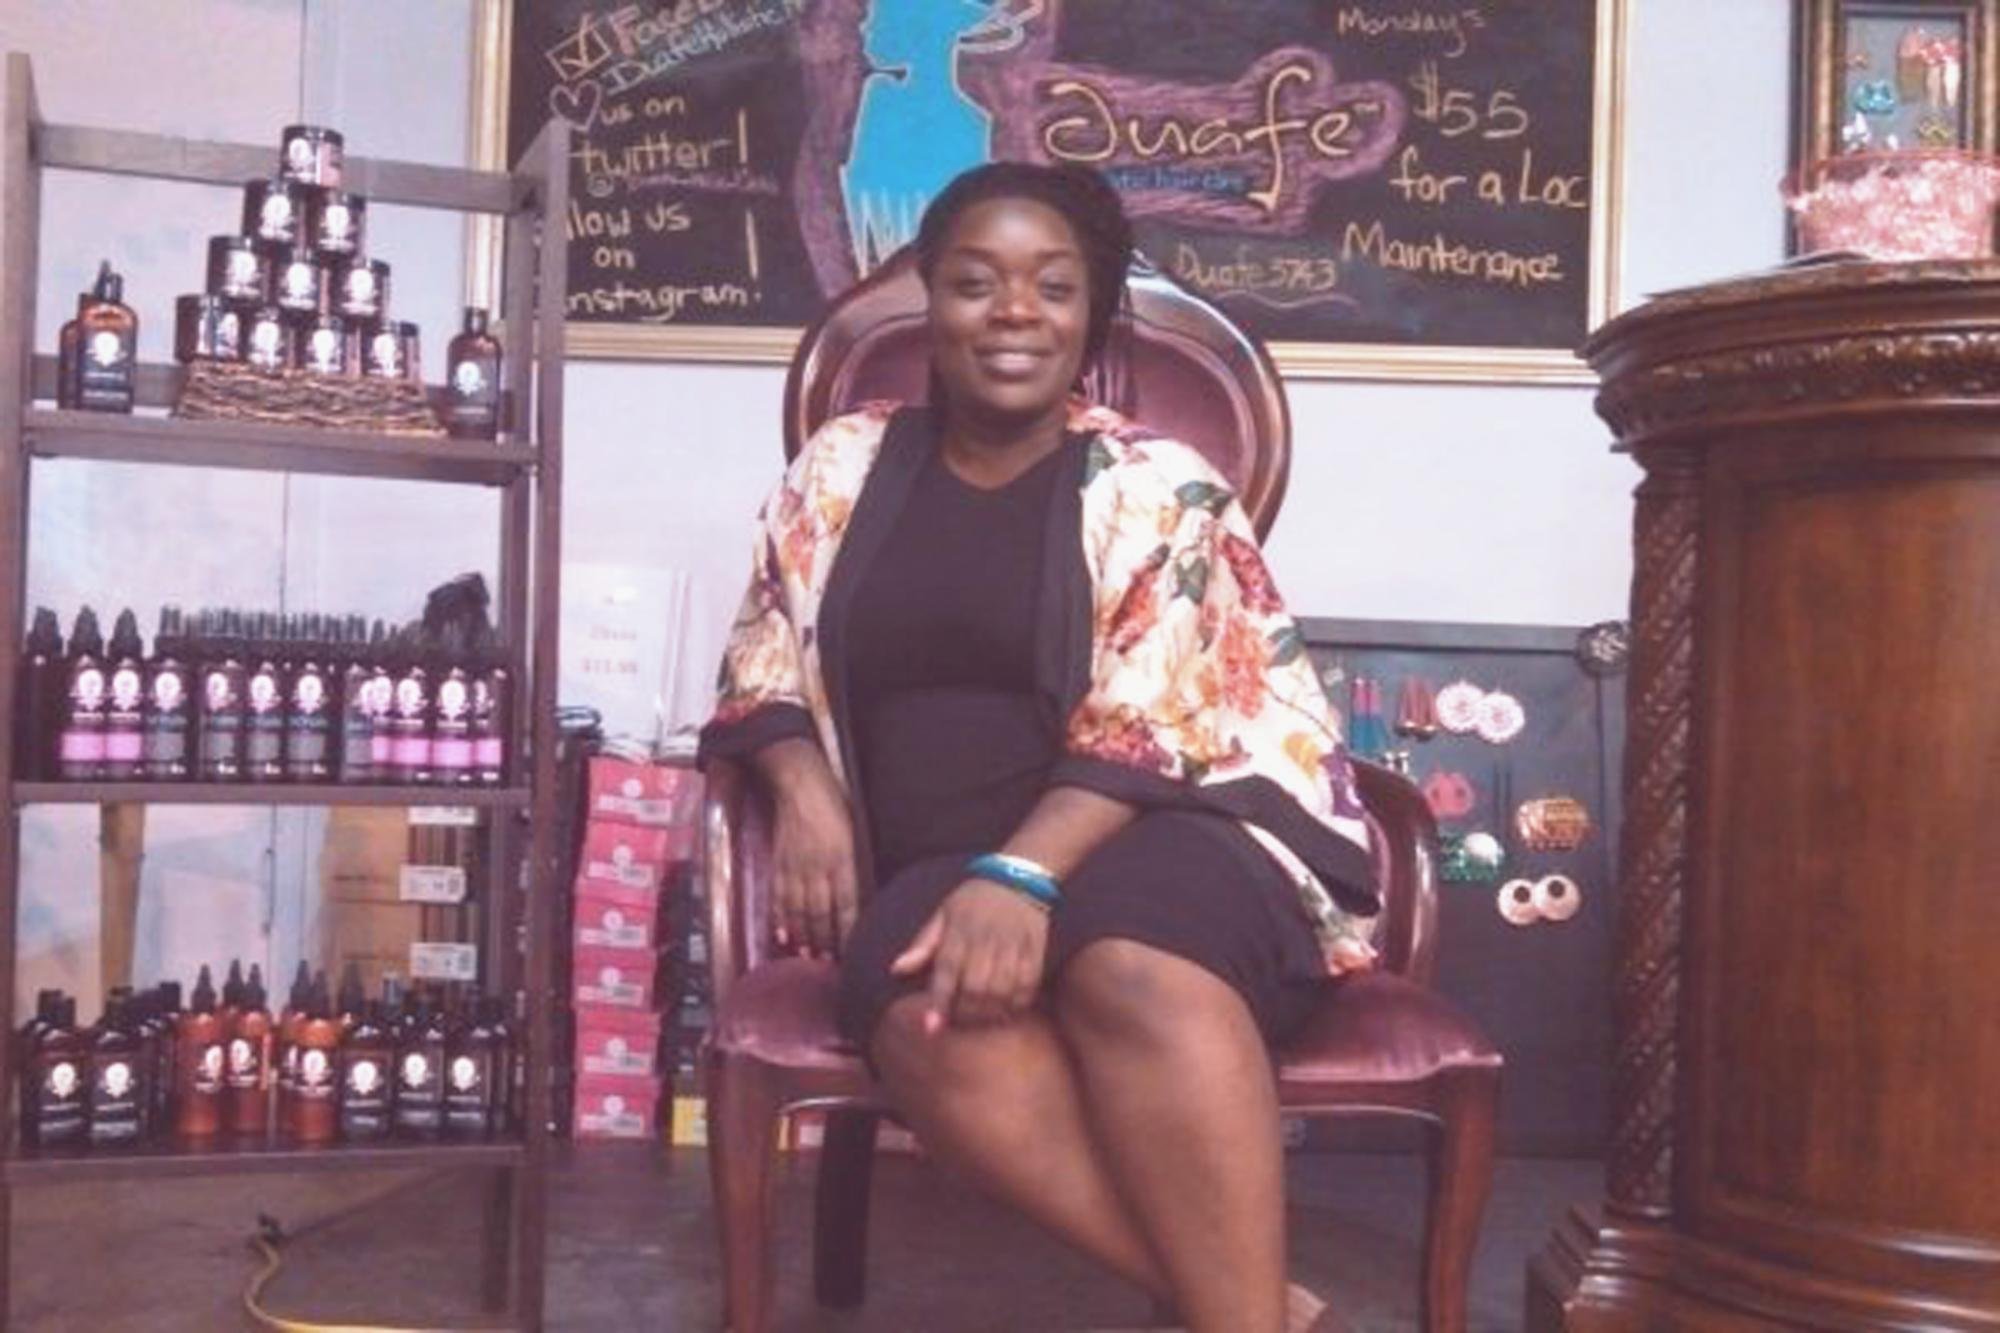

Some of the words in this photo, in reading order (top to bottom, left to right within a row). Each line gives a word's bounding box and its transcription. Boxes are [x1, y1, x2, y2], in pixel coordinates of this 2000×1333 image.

[600, 107, 634, 126] us
[645, 96, 686, 115] on
[1409, 60, 1530, 139] $55
[1389, 145, 1468, 204] for
[1478, 171, 1505, 205] a
[1519, 147, 1589, 208] Loc
[564, 200, 631, 241] llow
[593, 246, 635, 269] on
[1343, 219, 1564, 287] Maintenance
